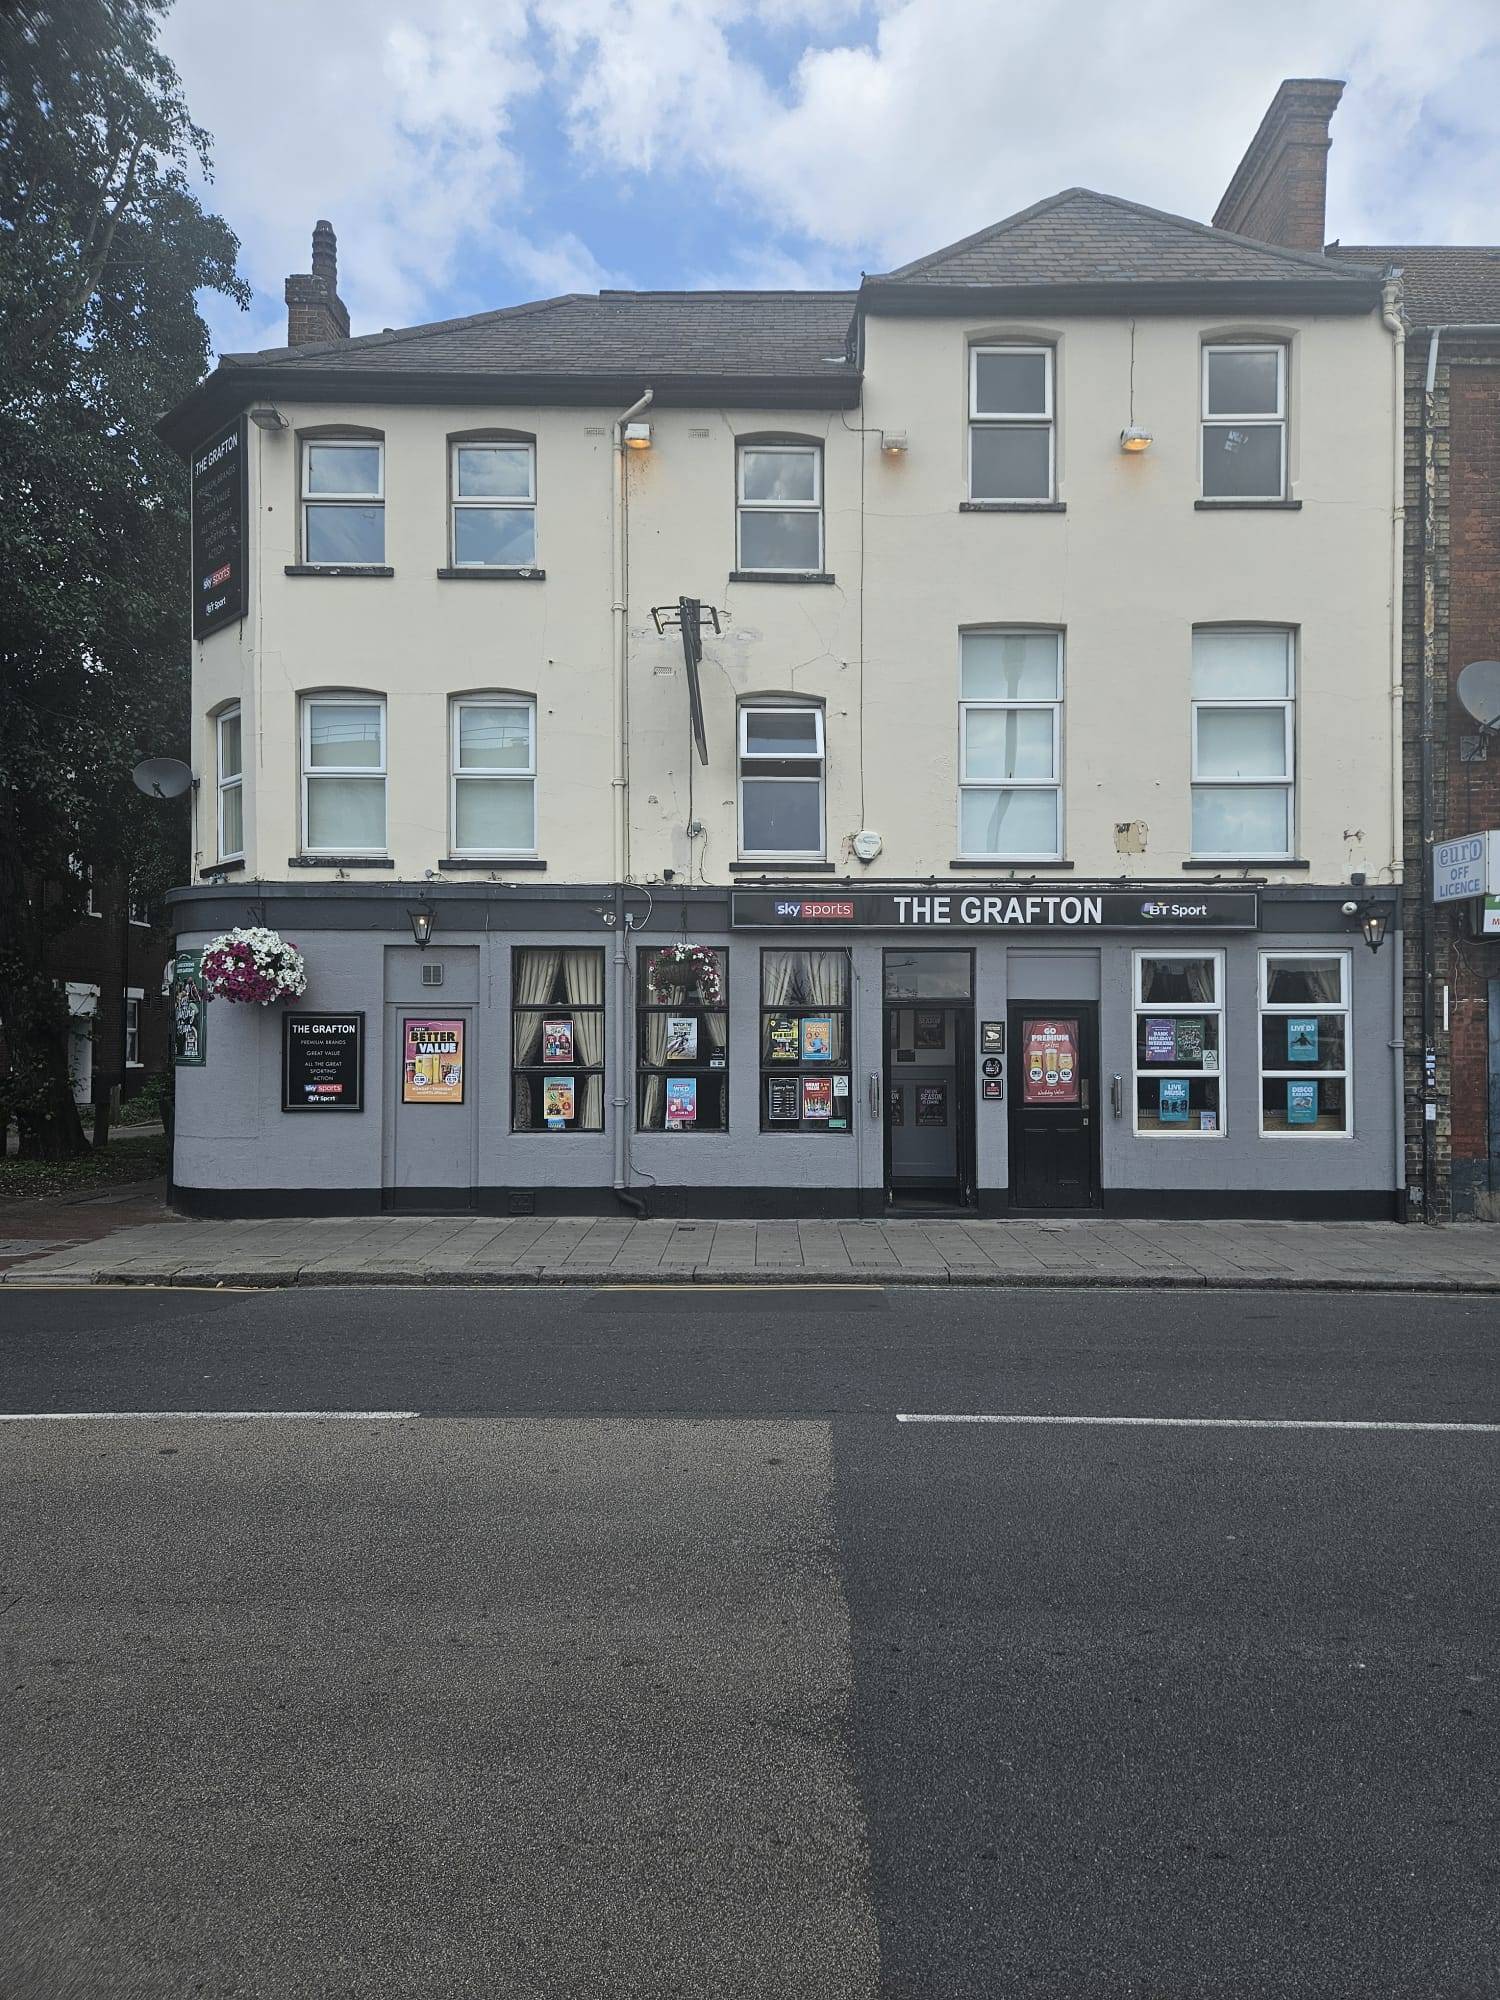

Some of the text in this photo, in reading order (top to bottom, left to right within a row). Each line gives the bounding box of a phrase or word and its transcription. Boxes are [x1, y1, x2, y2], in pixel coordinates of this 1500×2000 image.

[196, 432, 238, 475] THE GRAFTON
[203, 567, 230, 590] sky sports
[214, 597, 226, 610] Sport
[1440, 839, 1482, 866] euro
[1450, 866, 1469, 880] OFF
[1440, 879, 1480, 897] LICENCE
[777, 896, 1207, 924] sky sports THE GRAFTON BT Sport
[292, 1024, 356, 1034] THE GRAFTON
[1043, 1027, 1057, 1035] GO
[1306, 1024, 1315, 1032] DJ
[410, 1031, 456, 1041] BETTER
[1031, 1034, 1070, 1042] PREMIUM
[419, 1042, 457, 1053] VALUE
[305, 1084, 342, 1092] sky sports
[920, 1093, 942, 1101] SEASON
